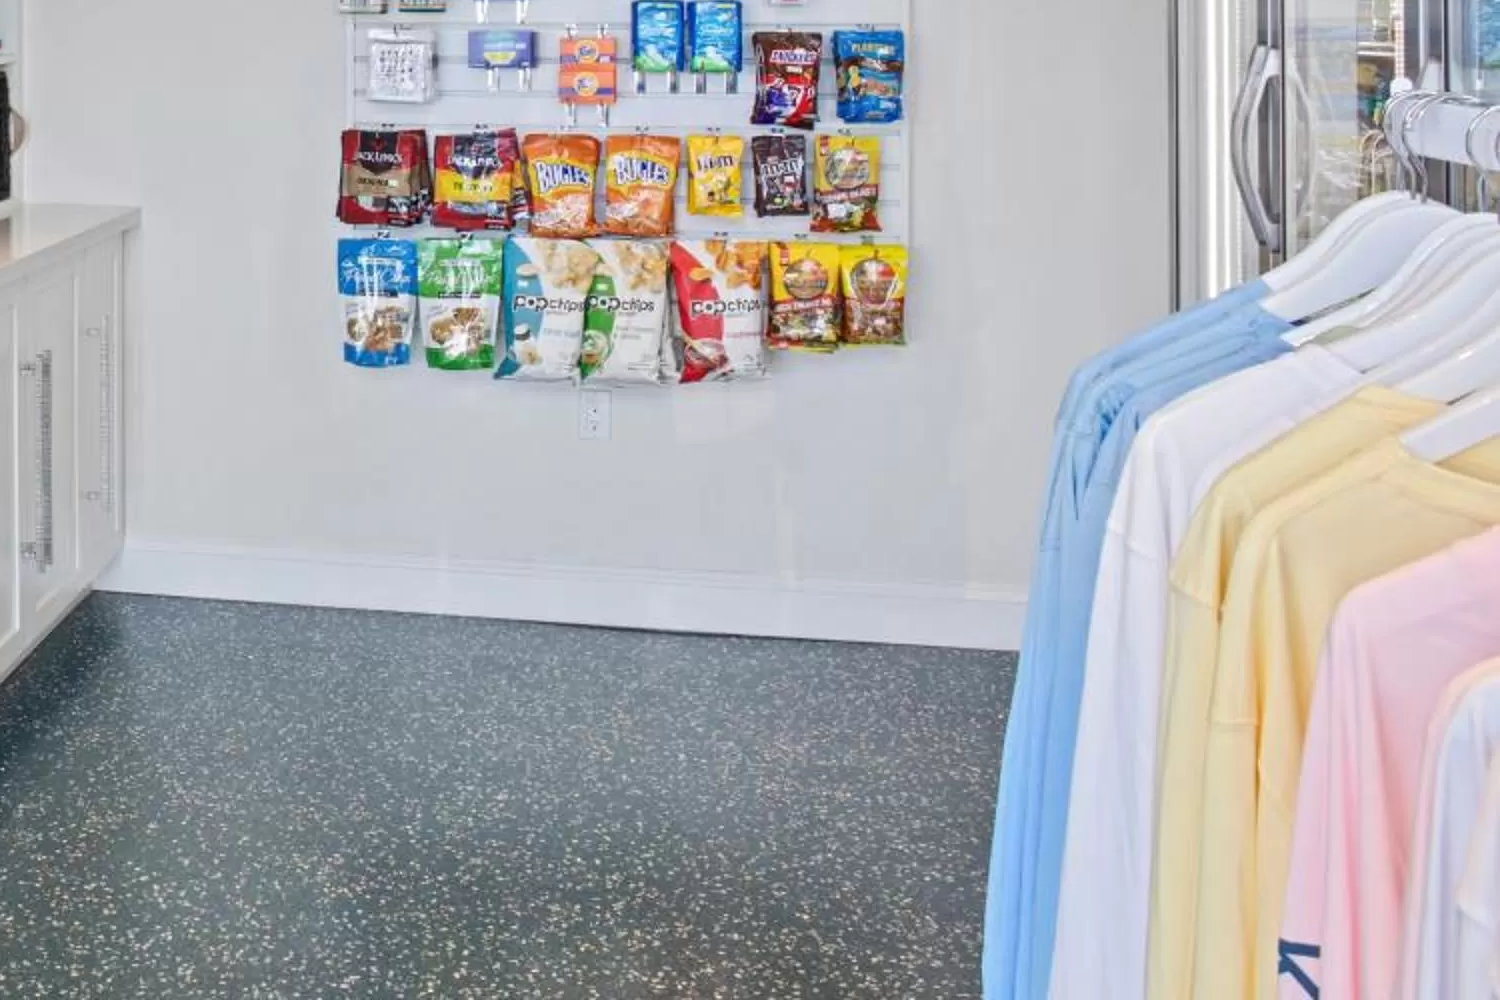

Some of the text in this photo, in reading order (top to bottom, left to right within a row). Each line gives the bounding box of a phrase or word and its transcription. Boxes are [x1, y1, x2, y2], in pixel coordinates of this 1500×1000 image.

[535, 160, 591, 194] BUGLES
[614, 155, 669, 185] BUGLES
[585, 294, 655, 312] popchips
